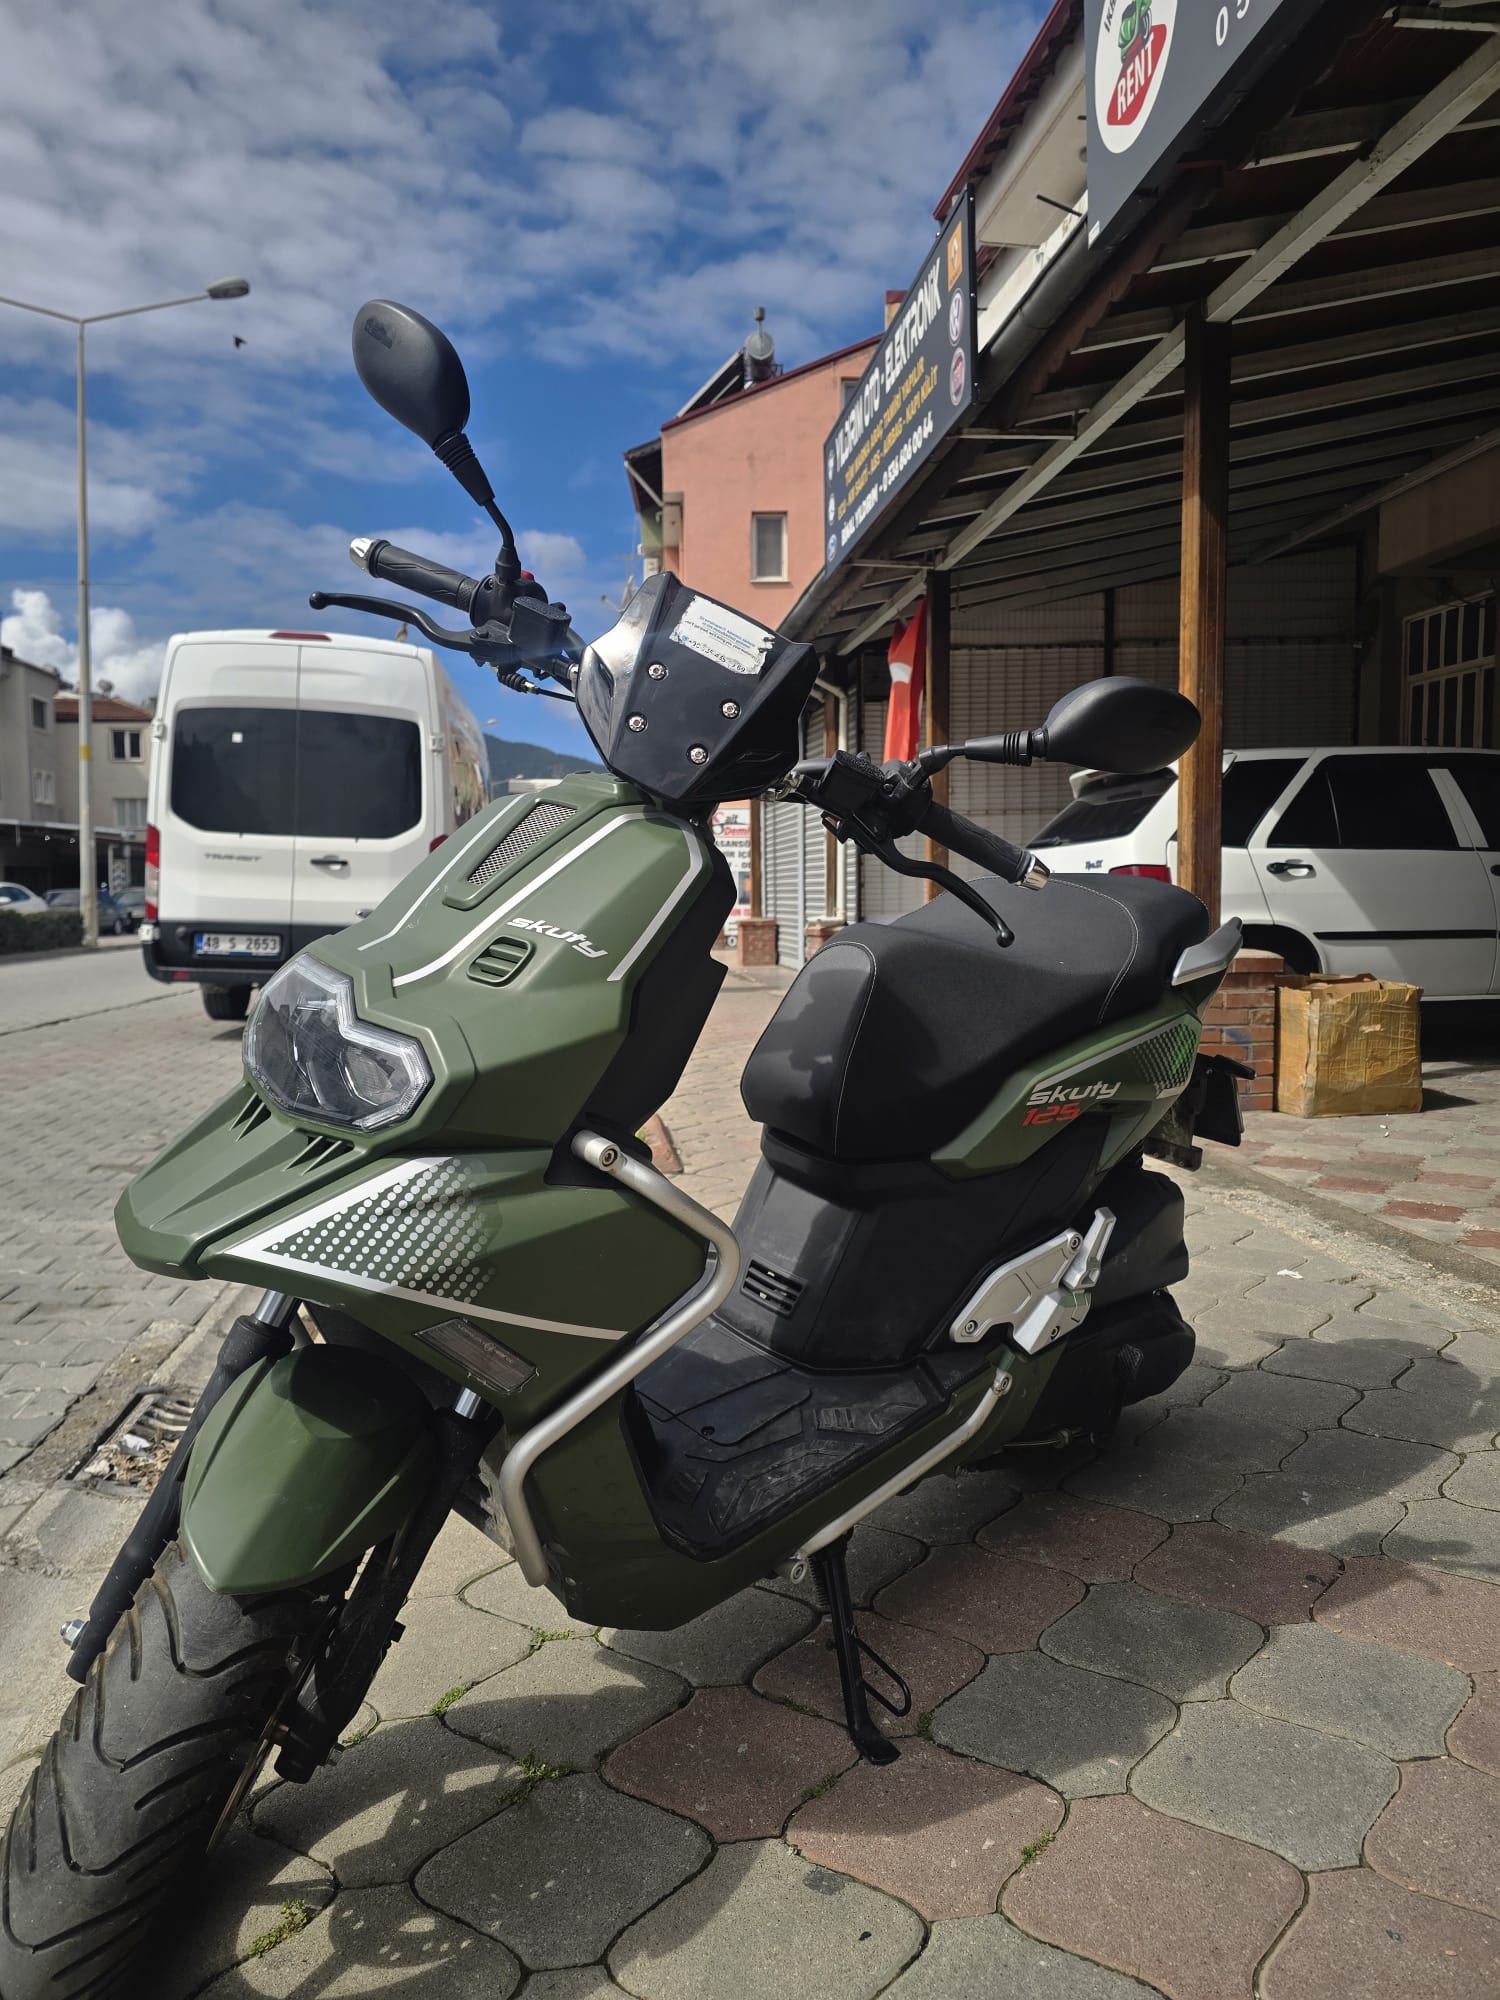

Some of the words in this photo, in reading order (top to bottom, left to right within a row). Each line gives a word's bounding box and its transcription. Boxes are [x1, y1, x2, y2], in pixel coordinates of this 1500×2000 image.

[1117, 32, 1154, 120] RENT
[864, 367, 880, 427] OTO
[885, 256, 942, 394] ELEKTRONİK
[229, 936, 238, 950] S
[246, 937, 279, 951] 2653
[1022, 1102, 1081, 1127] 125
